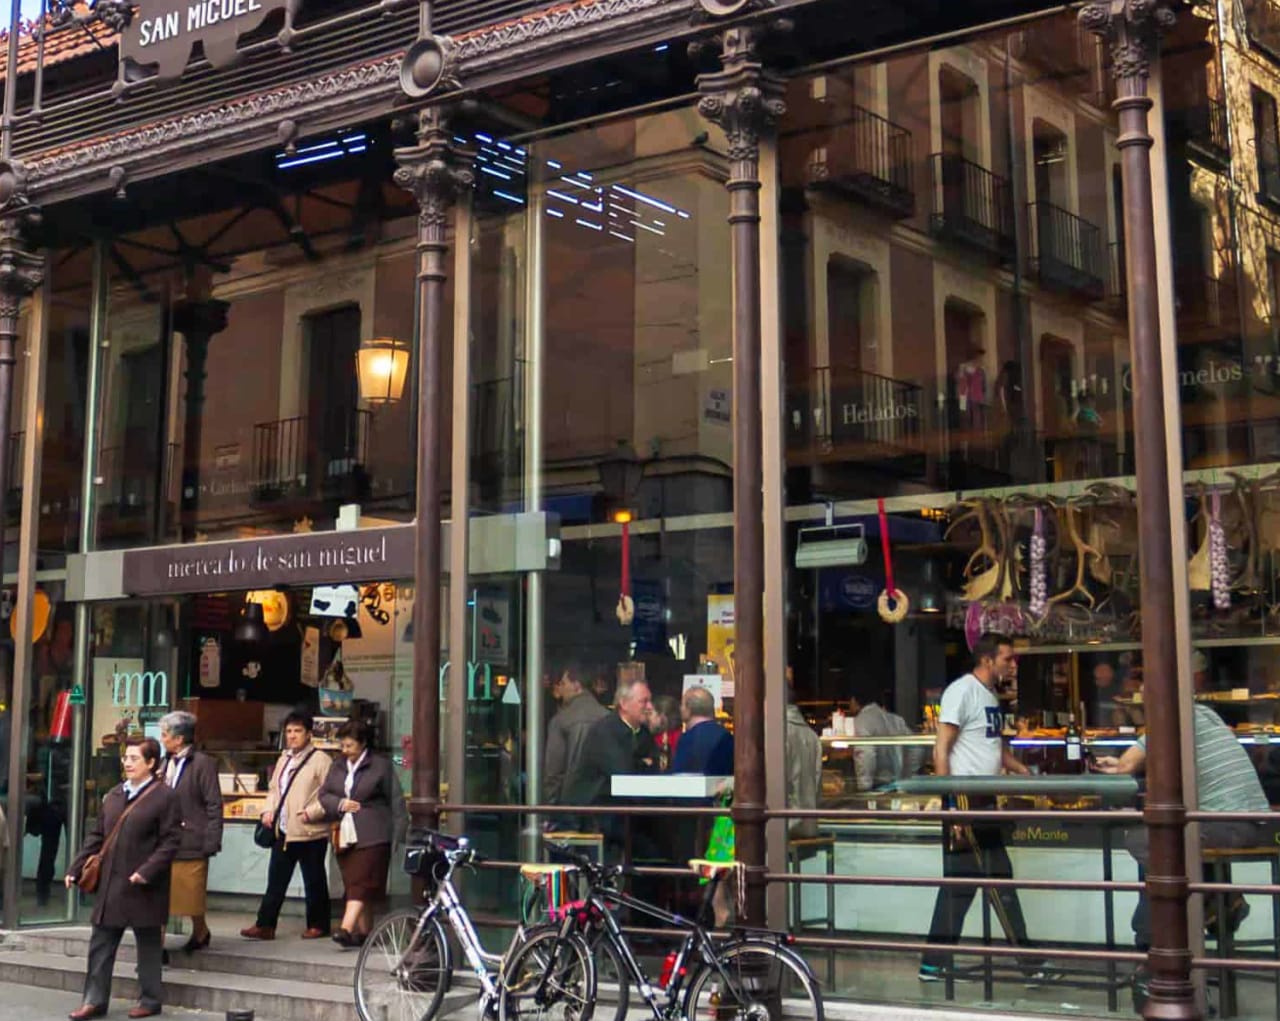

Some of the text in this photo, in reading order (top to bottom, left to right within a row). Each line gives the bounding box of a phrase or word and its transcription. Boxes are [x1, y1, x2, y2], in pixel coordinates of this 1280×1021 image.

[138, 11, 180, 47] SAN
[843, 401, 918, 425] Helados
[167, 535, 387, 578] mercado de san miguel
